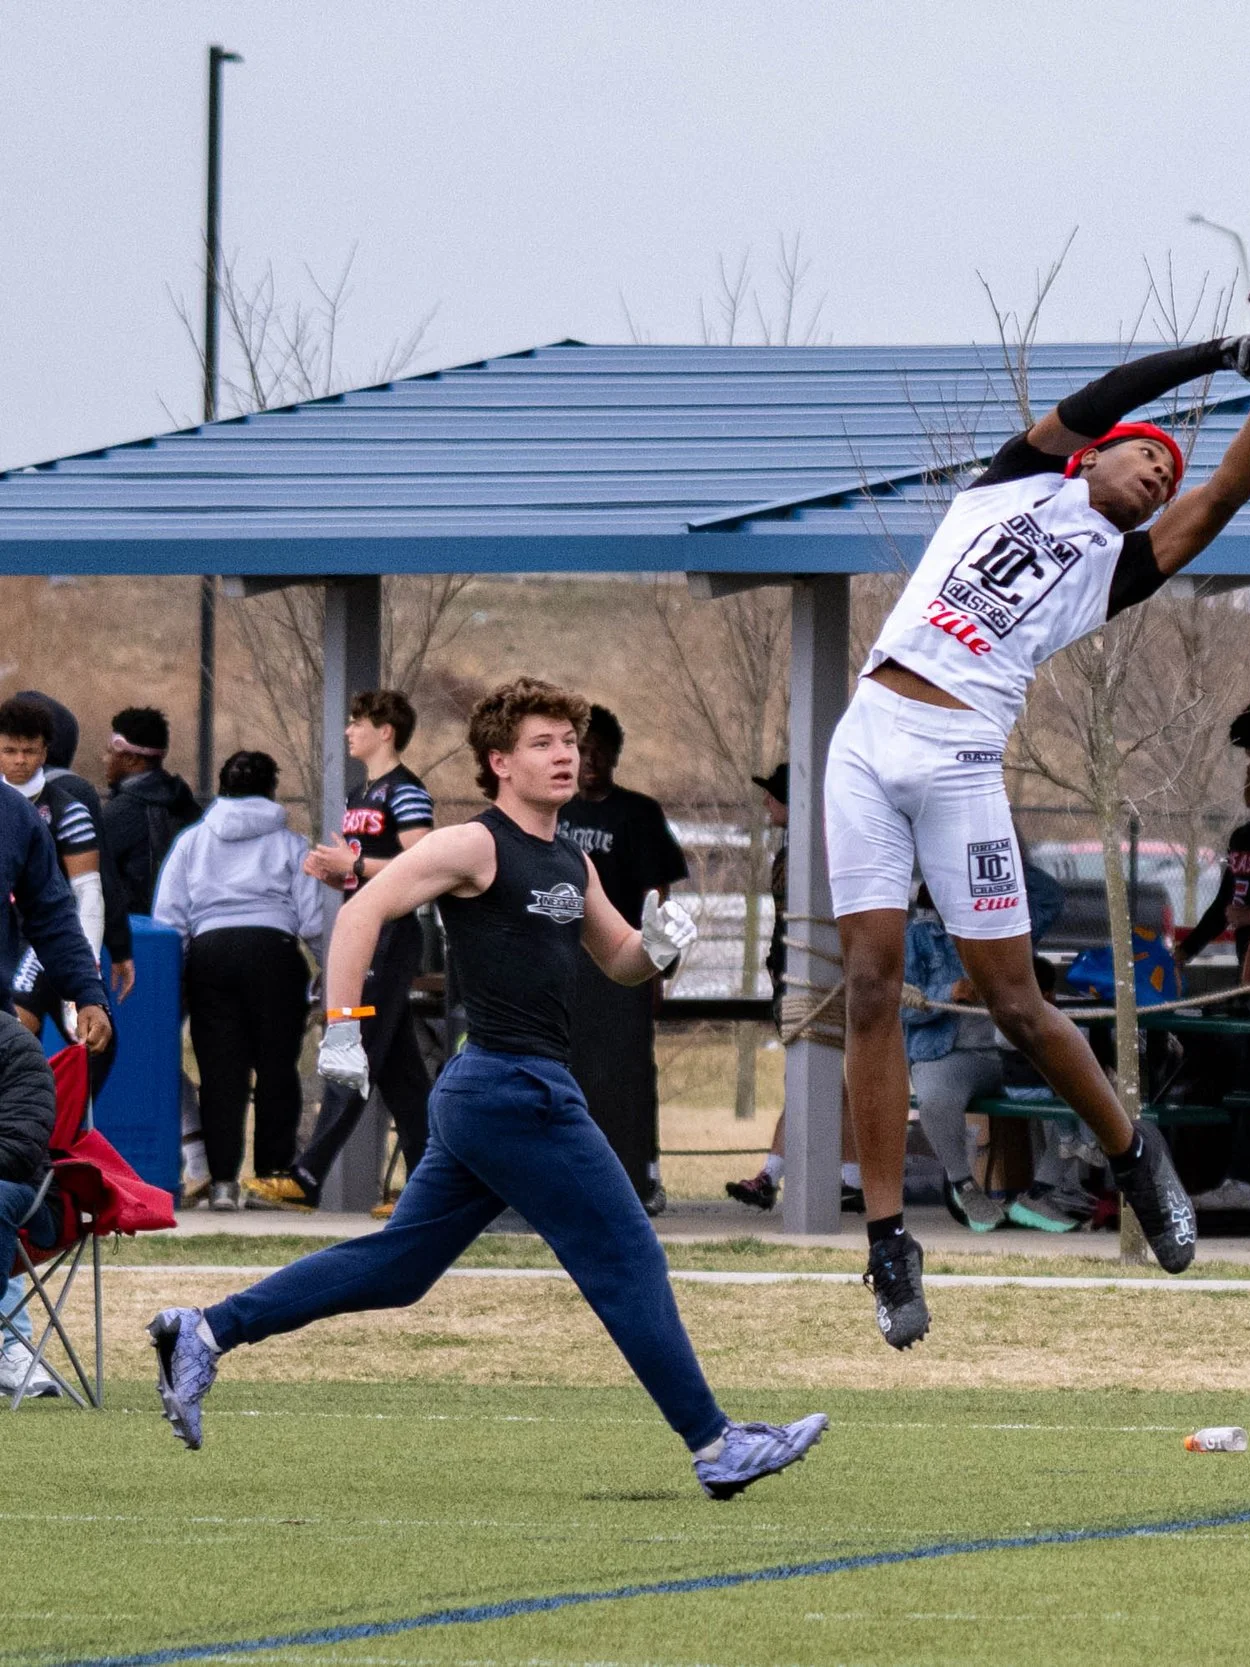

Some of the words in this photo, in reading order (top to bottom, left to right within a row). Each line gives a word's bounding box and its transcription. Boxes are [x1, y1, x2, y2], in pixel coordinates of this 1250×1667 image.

[1007, 514, 1075, 565] DRM
[342, 810, 384, 834] EASTS
[972, 841, 1009, 852] DREAM
[974, 896, 1019, 912] Elite
